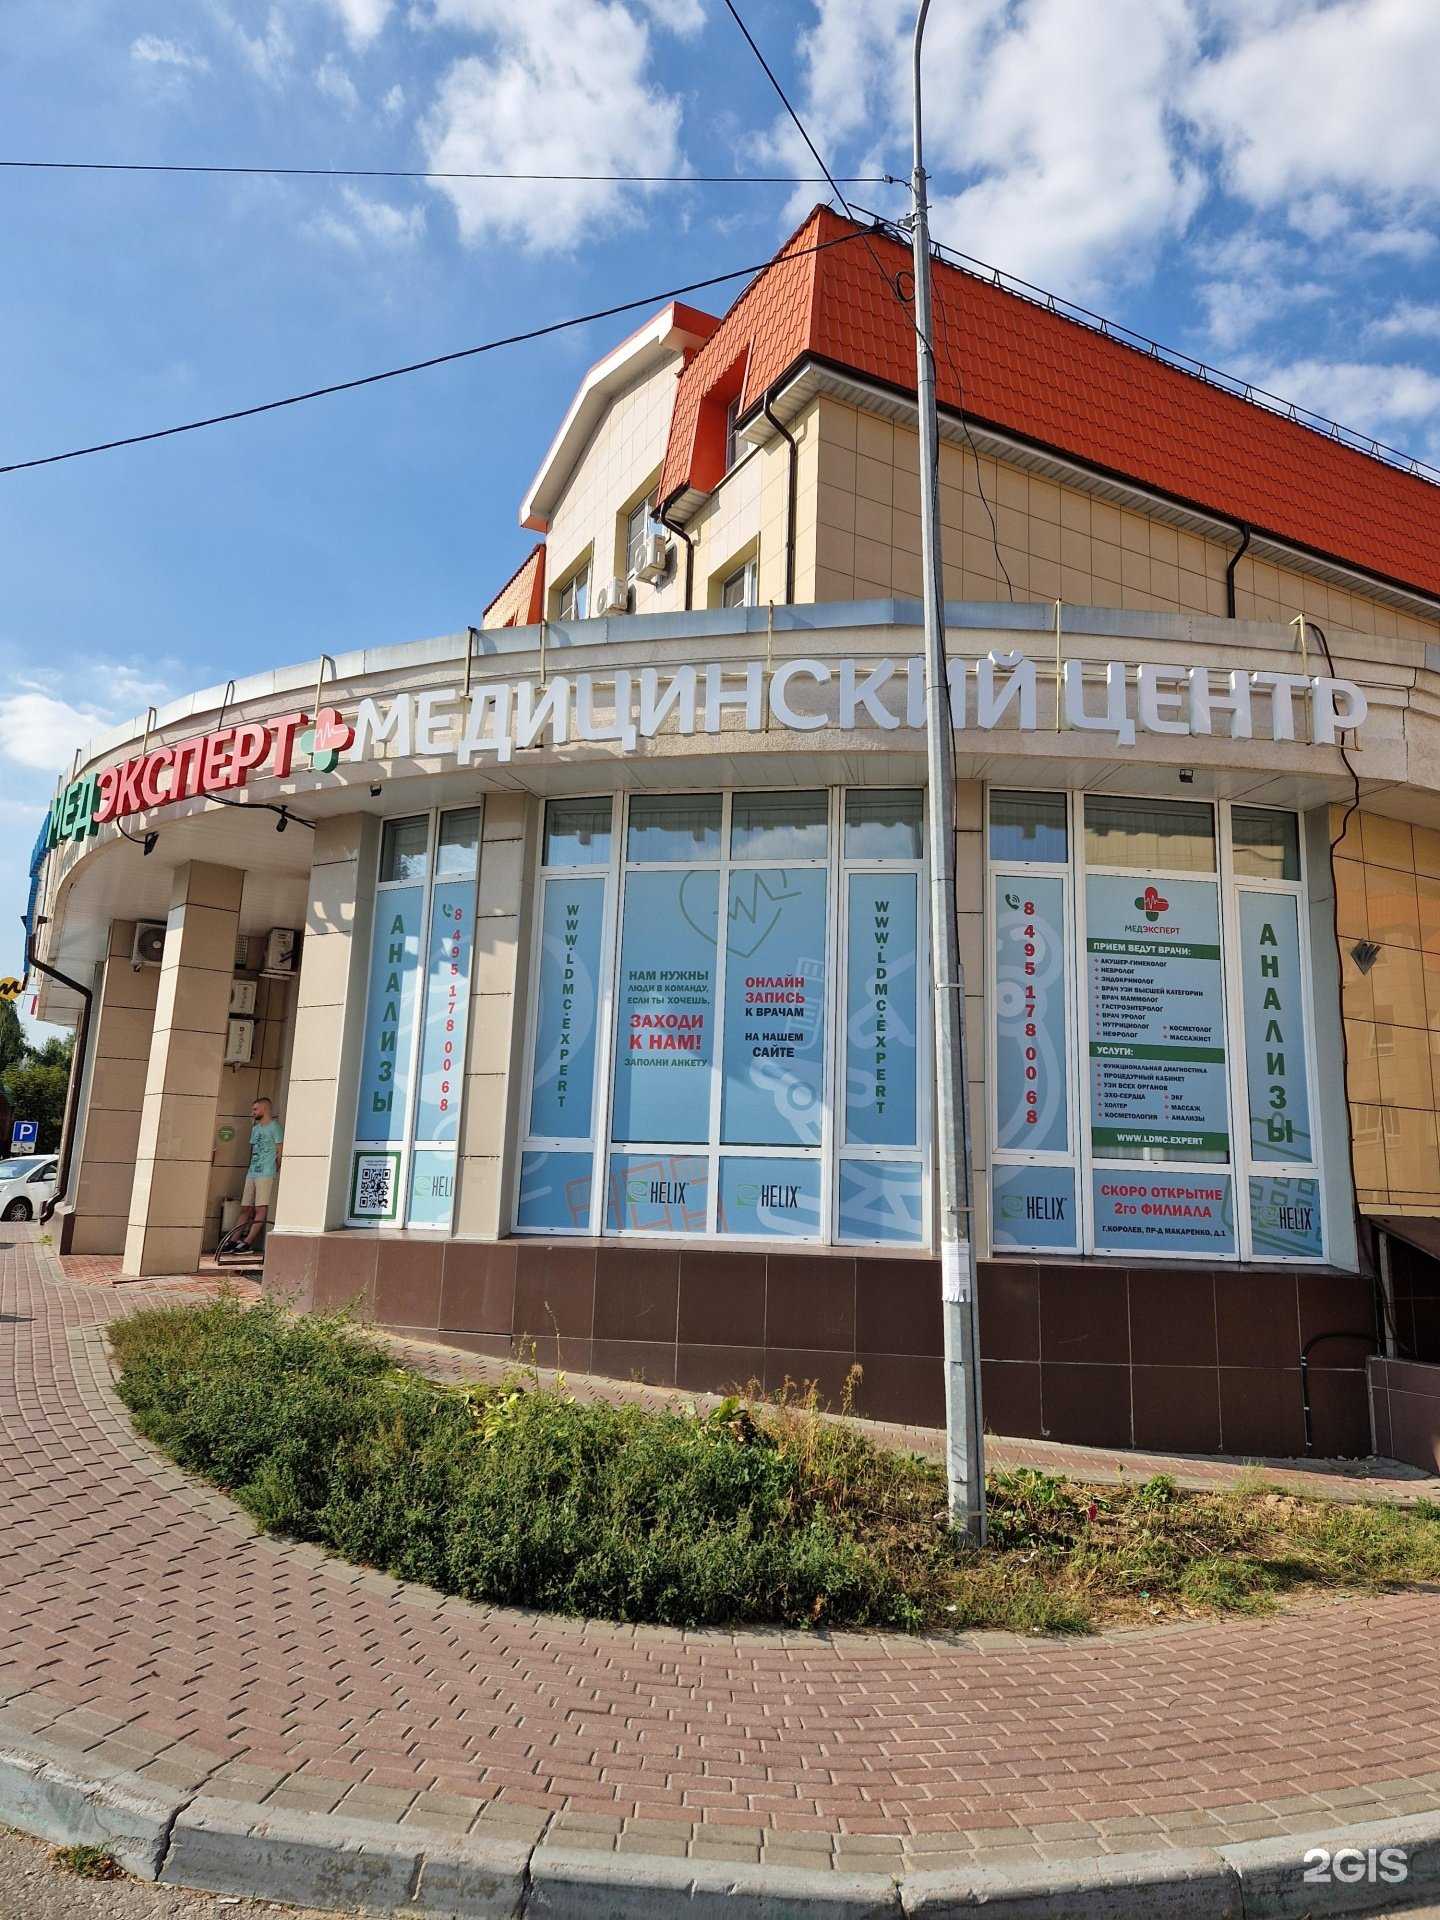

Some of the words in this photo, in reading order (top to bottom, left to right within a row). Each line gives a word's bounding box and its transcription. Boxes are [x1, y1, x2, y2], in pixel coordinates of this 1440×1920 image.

[350, 649, 1037, 764] МЕДИЦИНСКИЙ
[1064, 659, 1369, 748] ЦЕНТР
[46, 713, 309, 850] МЕДЭКСПЕРТ
[1024, 901, 1035, 915] 8
[1124, 924, 1181, 935] МЕДЭКСПЕРТ
[1024, 925, 1036, 976] 495
[1093, 942, 1126, 952] ПРИЕМ
[1128, 945, 1156, 954] ВЕДУТ
[1158, 946, 1192, 955] ВРАЧИ:
[1101, 958, 1167, 967] АКУШЕР-ГИНЕКОЛОГ
[629, 971, 657, 981] НАМ
[660, 971, 709, 981] НУЖНЫ
[745, 973, 805, 988] ОНЛАЙН
[1101, 976, 1154, 984] ЭНДОКРИНОЛОГ
[628, 985, 654, 993] ЛЮДИ
[1101, 985, 1119, 993] ВРАЧ
[1134, 987, 1165, 995] ВЫСШЕЙ
[1166, 989, 1204, 997] КАТЕГОРИИ
[627, 997, 651, 1005] ЕСЛИ
[745, 991, 805, 1004] ЗАПИСЬ
[1120, 995, 1159, 1003] МАММОЛОГ
[557, 904, 580, 1108] WWW.LDMC.EXPERT
[874, 901, 889, 1114] WWW.LDMC.EXPERT
[1025, 985, 1036, 1037] 178
[1101, 1003, 1164, 1012] ГАСТРОЭНТЕРОЛОГ
[372, 914, 405, 1113] АНАЛИЗЫ
[745, 1008, 753, 1017] К
[756, 1008, 804, 1017] ВРАЧАМ
[630, 1014, 704, 1031] ЗАХОДИ
[1102, 1021, 1150, 1030] НУТРИЦИОЛОГ
[1103, 1030, 1139, 1038] НЕФРОЛОГ
[1169, 1025, 1213, 1033] КОСМЕТОЛОГ
[1259, 923, 1293, 1143] АНАЛИЗЫ
[630, 1035, 642, 1050] К
[649, 1034, 702, 1050] НАМ!
[745, 1032, 759, 1041] НА
[763, 1033, 804, 1041] НАШЕМ
[1170, 1034, 1212, 1042] МАССАЖИСТ
[752, 1044, 795, 1058] САЙТЕ
[1096, 1046, 1134, 1056] УСЛУГИ:
[624, 1058, 669, 1067] ЗАПОЛНИ
[671, 1058, 708, 1067] АНКЕТУ
[1103, 1063, 1163, 1072] ФУНКЦИОНАЛЬНАЯ
[1163, 1066, 1208, 1074] ДИАГНОСТИКА
[1103, 1072, 1154, 1081] ПРОЦЕДУРНЫЙ
[1104, 1112, 1158, 1121] КОСМЕТОЛОГИЯ
[1171, 1114, 1205, 1122] АНАЛИЗЫ
[20, 1124, 33, 1140] P
[1117, 1134, 1204, 1145] WWW.LDMC.EXPERT
[432, 1176, 453, 1197] HELI
[1101, 1184, 1147, 1197] СКОРО
[1151, 1186, 1222, 1201] ОТКРЫТИЕ
[650, 1181, 687, 1205] HELIX
[761, 1184, 798, 1208] HELIX
[1027, 1196, 1065, 1220] HELIX
[1114, 1203, 1137, 1215] 2го
[1141, 1203, 1212, 1218] ФИЛИАЛА
[1279, 1206, 1312, 1230] HELIX
[1145, 1226, 1164, 1235] ПР-Д
